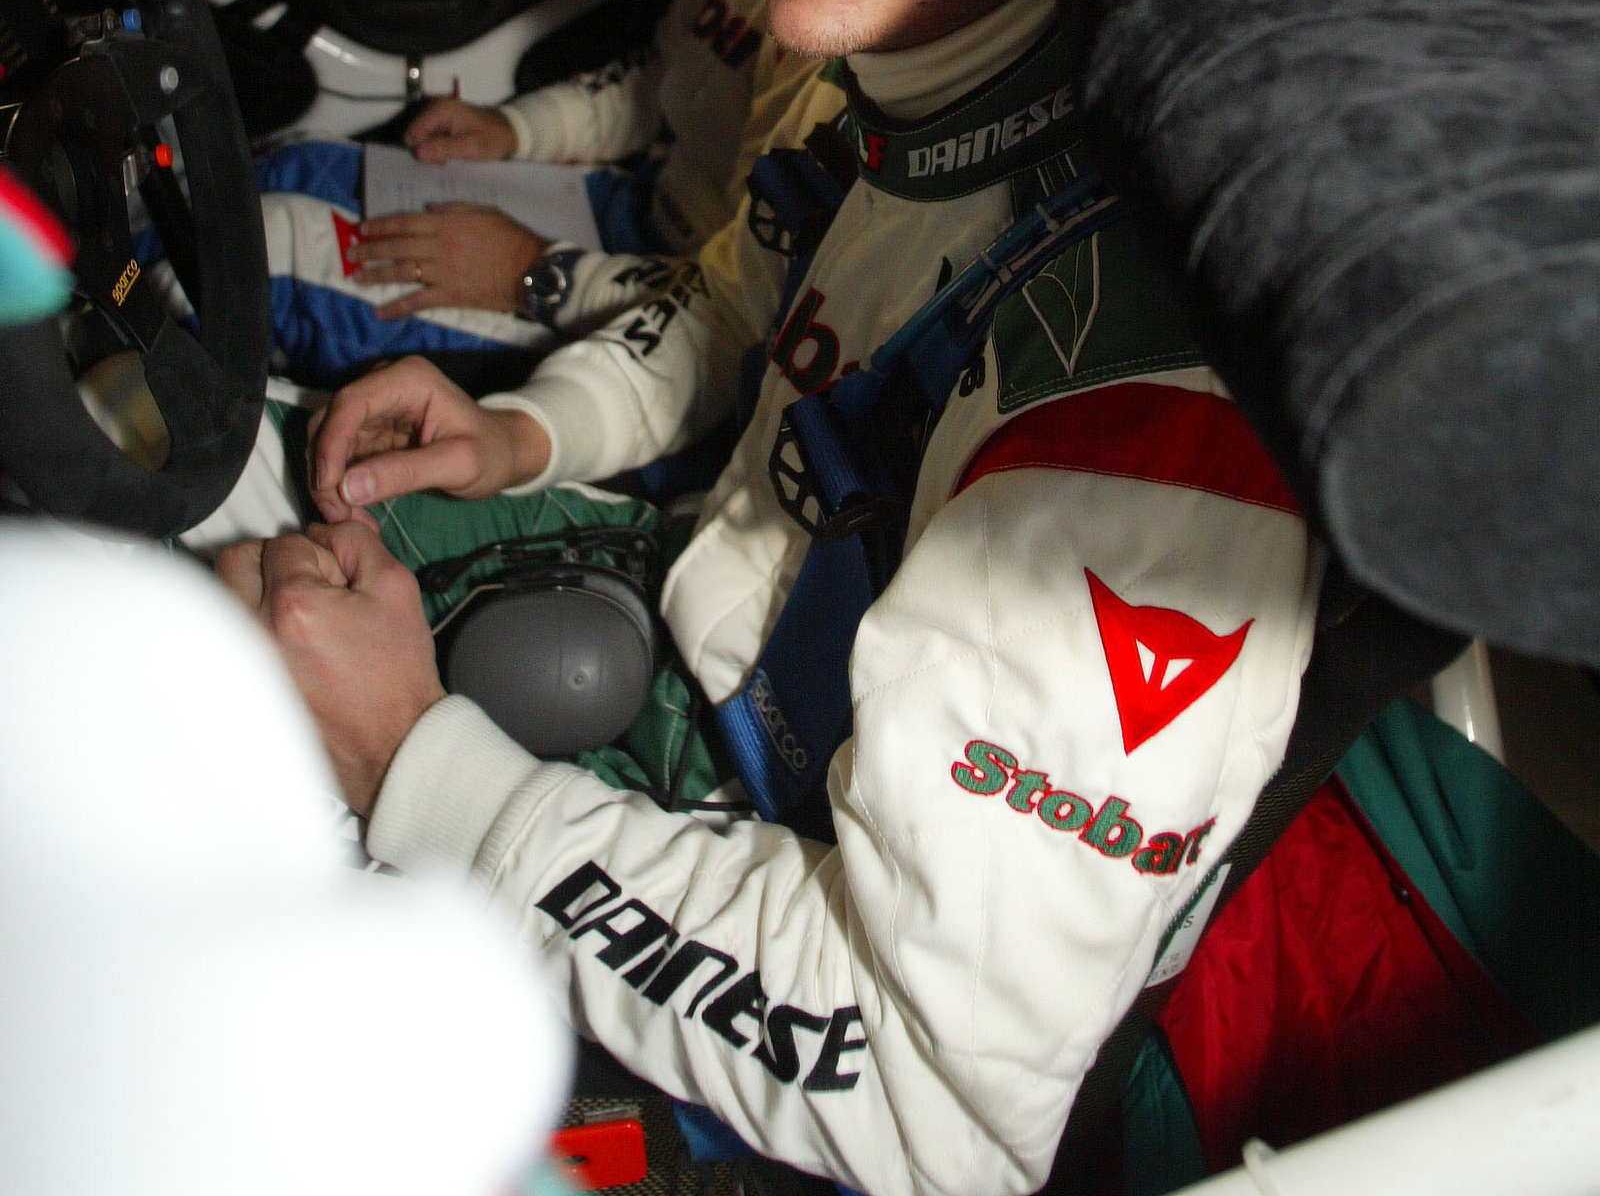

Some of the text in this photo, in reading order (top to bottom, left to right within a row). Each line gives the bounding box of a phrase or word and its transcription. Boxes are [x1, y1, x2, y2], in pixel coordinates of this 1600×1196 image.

[907, 83, 1074, 178] DAINESE
[112, 258, 140, 306] sparco
[534, 860, 868, 1092] DAINESE
